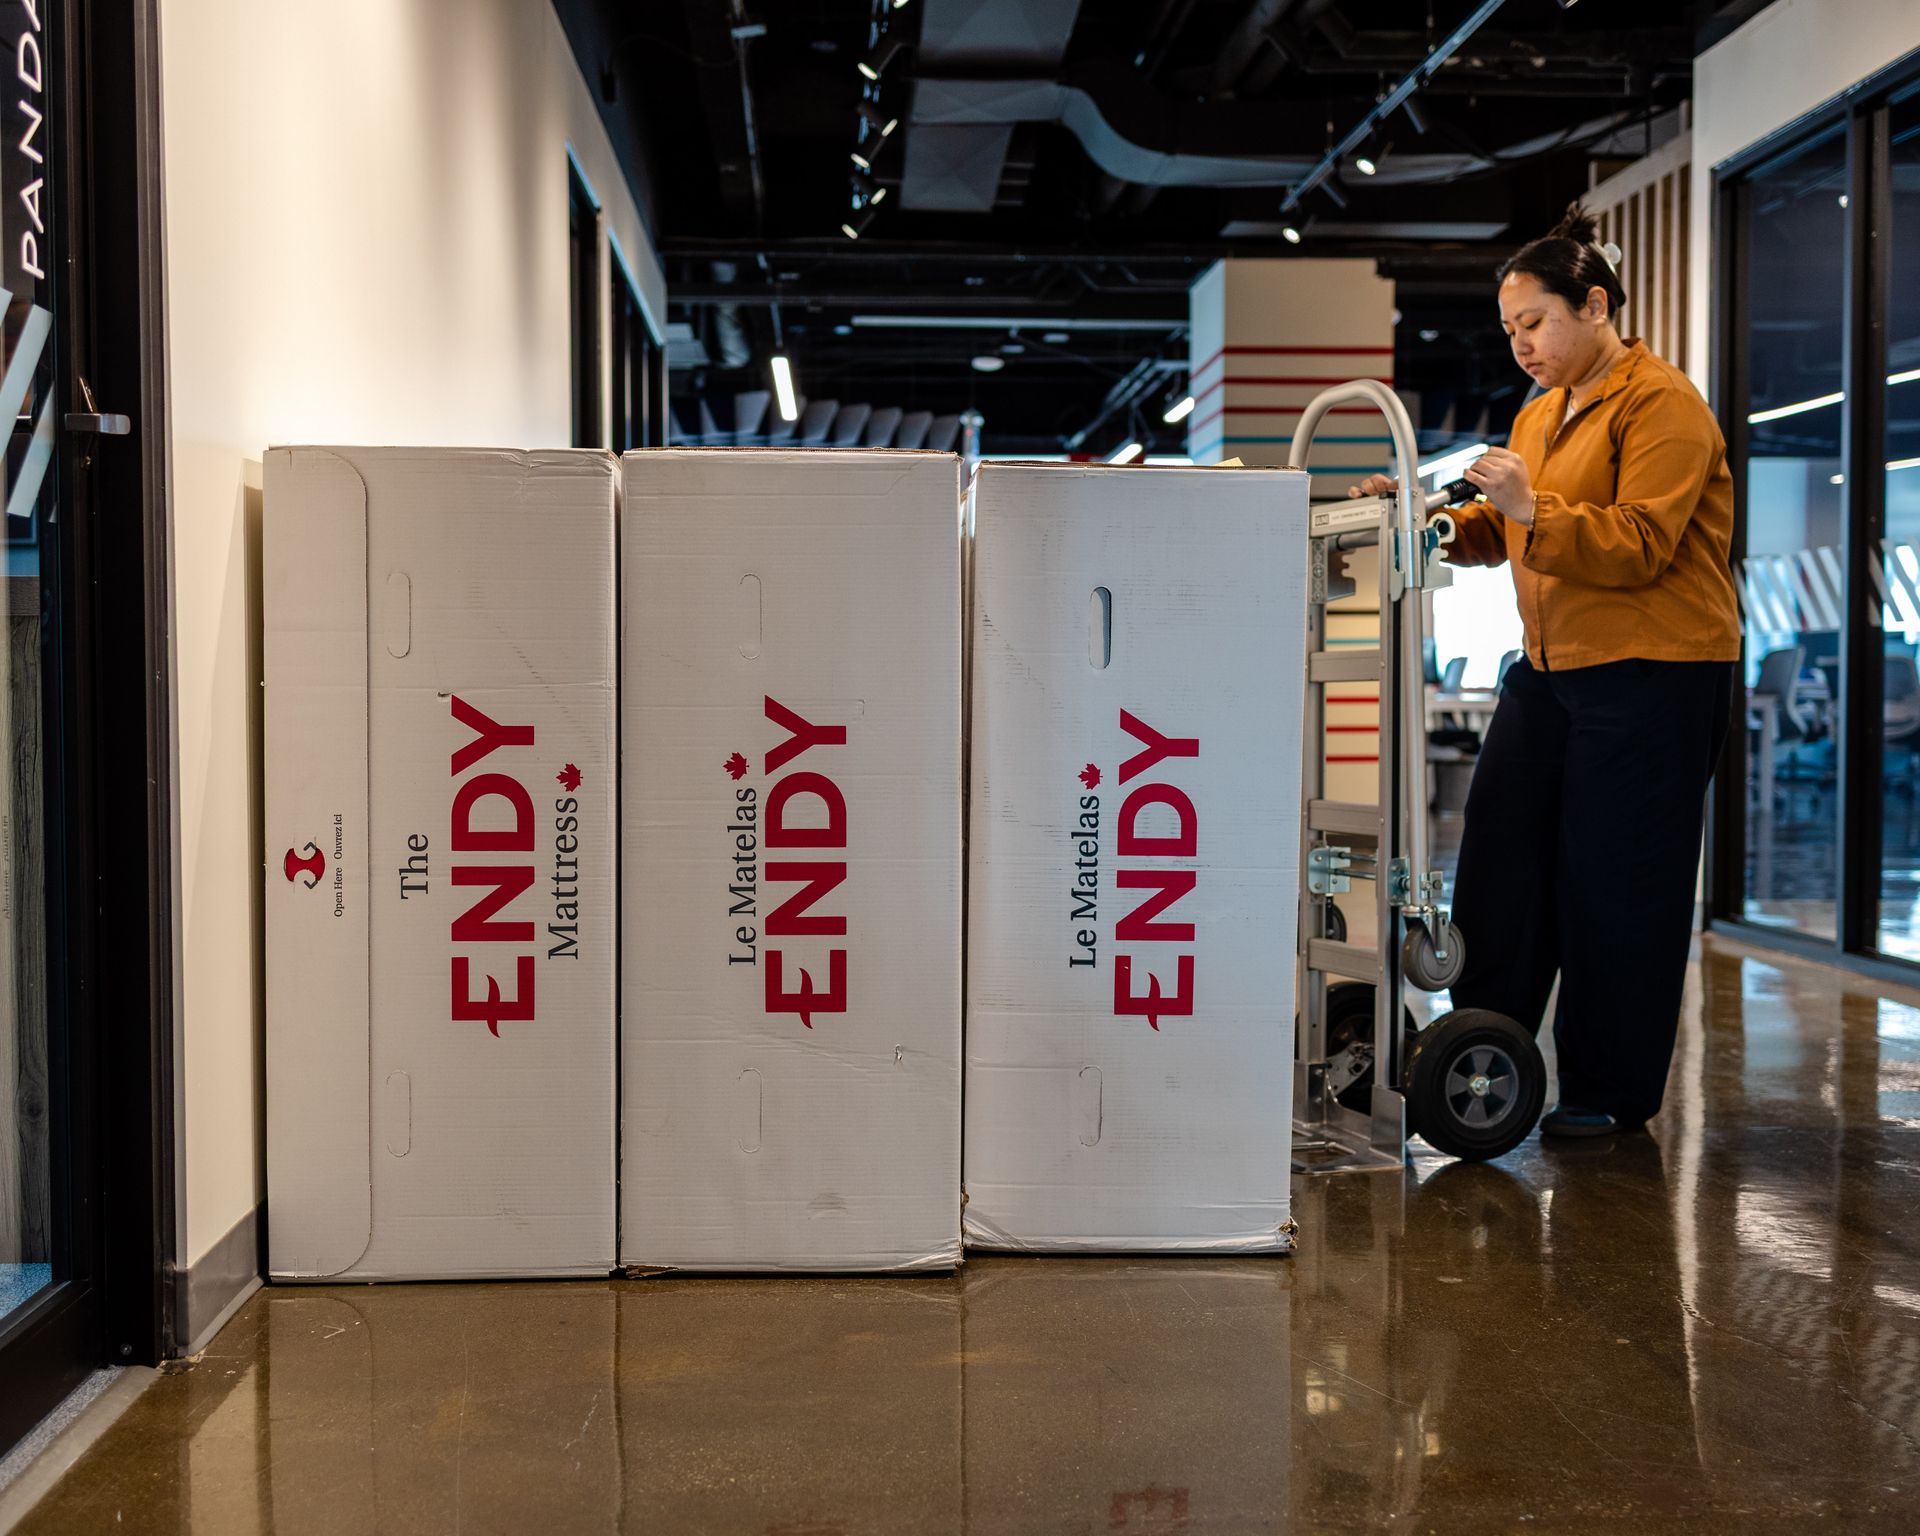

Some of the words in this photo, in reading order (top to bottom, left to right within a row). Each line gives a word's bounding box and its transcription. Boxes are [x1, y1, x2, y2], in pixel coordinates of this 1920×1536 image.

[333, 826, 343, 860] Ouvrez
[333, 867, 343, 890] Here
[399, 833, 429, 900] The
[451, 695, 535, 1036] ENDY
[547, 797, 579, 961] Mattress
[726, 787, 757, 918] Matelas
[764, 694, 847, 1029] ENDY
[1069, 795, 1100, 922] Matelas
[1114, 707, 1200, 1032] ENDY
[333, 891, 345, 919] Open
[728, 926, 757, 967] Le
[1068, 929, 1099, 969] Le
